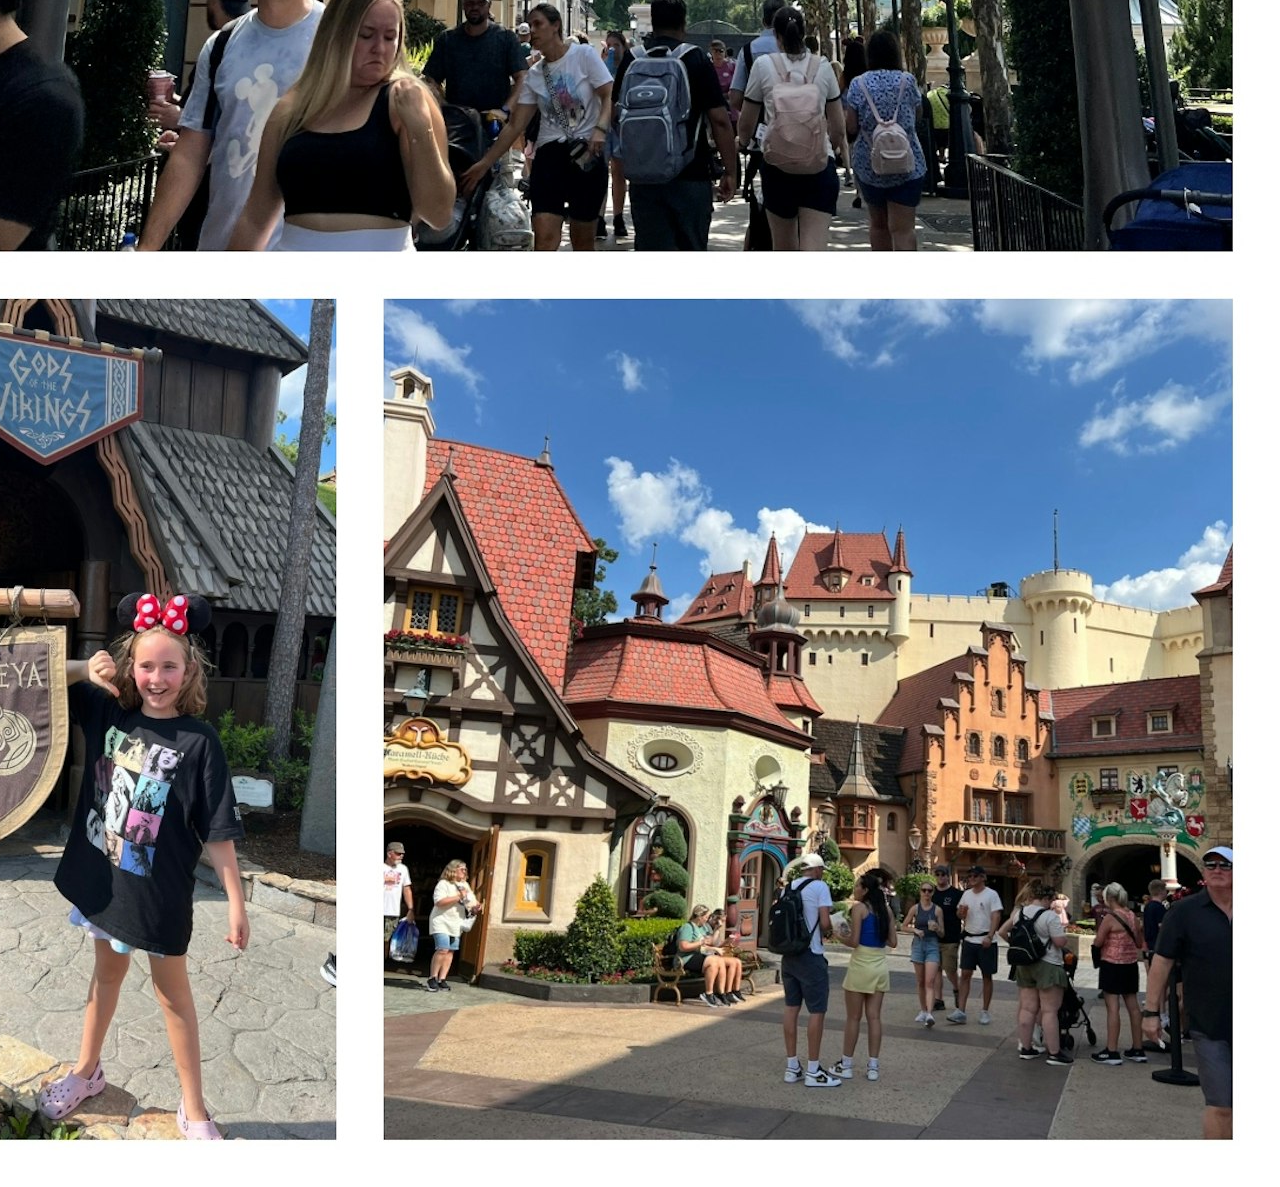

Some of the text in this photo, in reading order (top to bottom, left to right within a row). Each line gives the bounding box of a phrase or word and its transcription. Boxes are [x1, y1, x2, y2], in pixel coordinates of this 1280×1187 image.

[8, 347, 73, 395] GODS
[28, 378, 57, 392] OF THE
